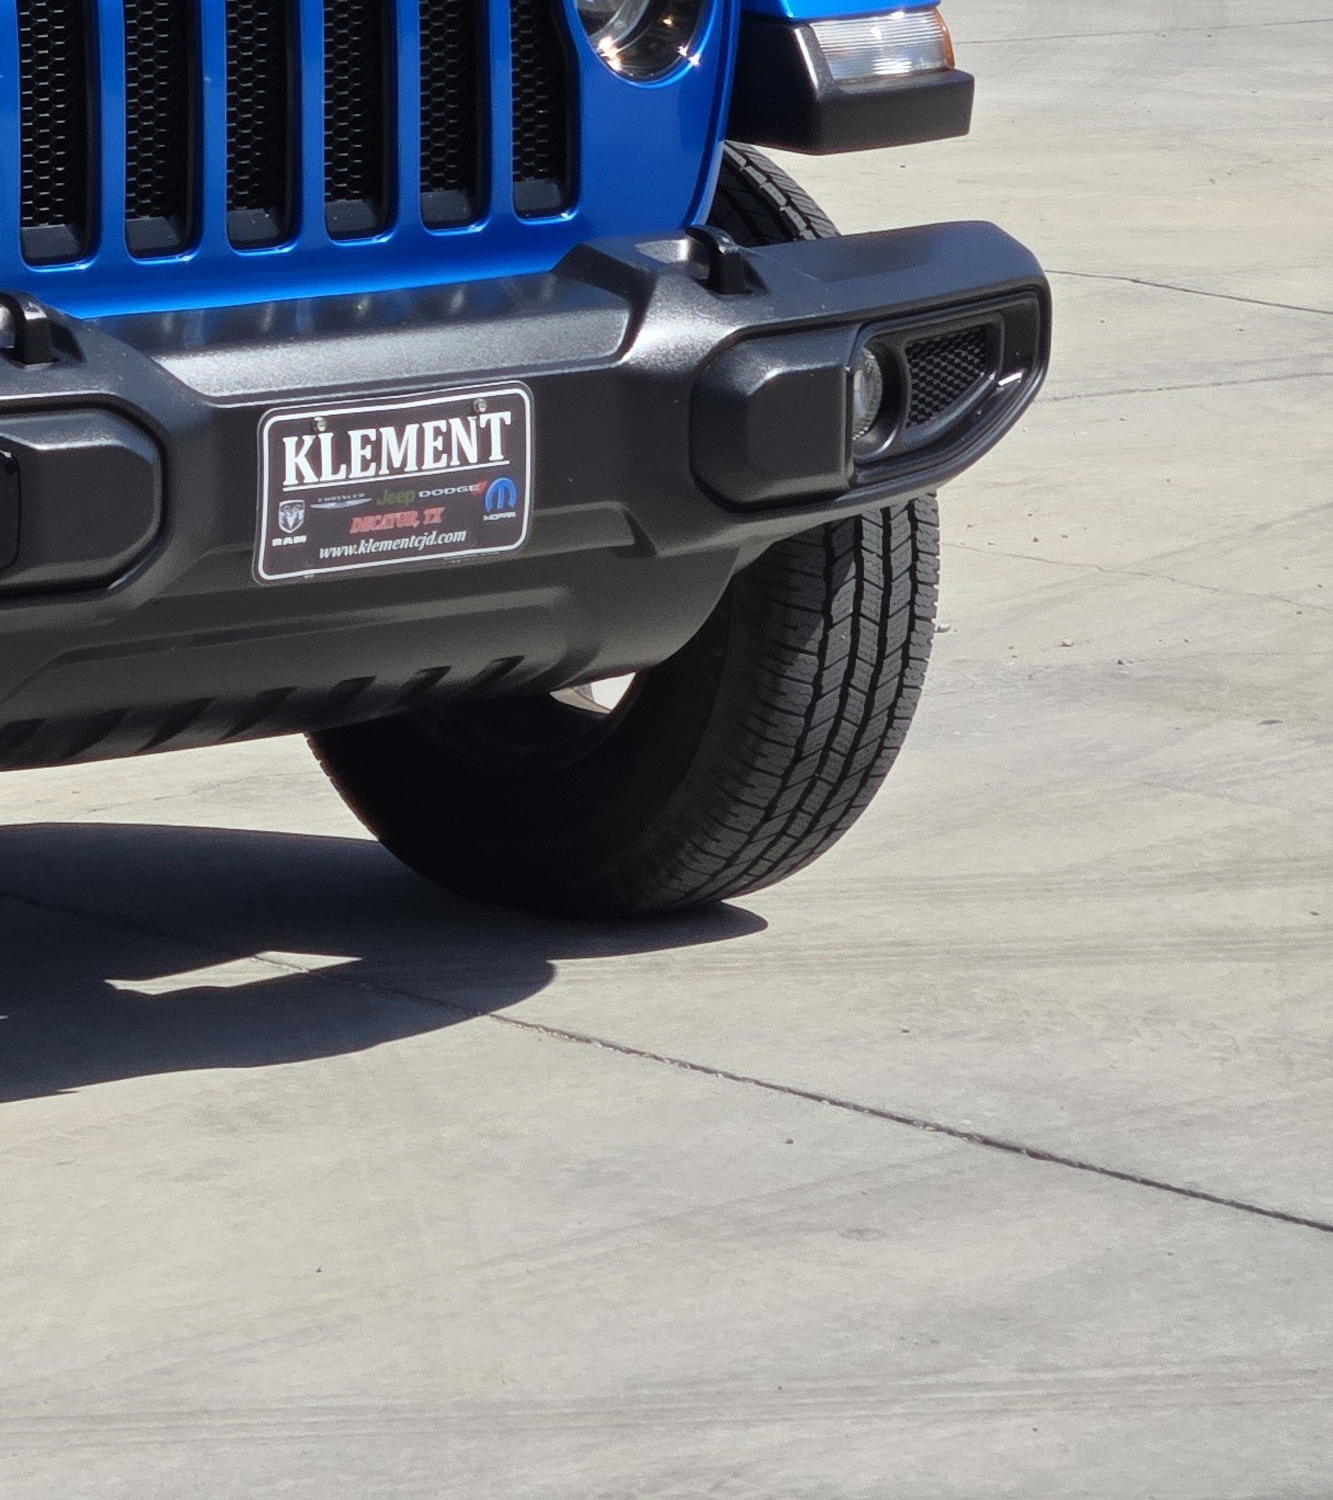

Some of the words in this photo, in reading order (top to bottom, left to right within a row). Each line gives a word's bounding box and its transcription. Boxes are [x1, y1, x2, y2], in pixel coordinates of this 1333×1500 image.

[282, 411, 511, 487] KLEMENT
[376, 488, 415, 506] Jeep
[418, 484, 479, 498] DODGE
[423, 507, 446, 525] TX
[272, 535, 307, 547] RAM
[318, 529, 467, 559] www.klementcjd.com
